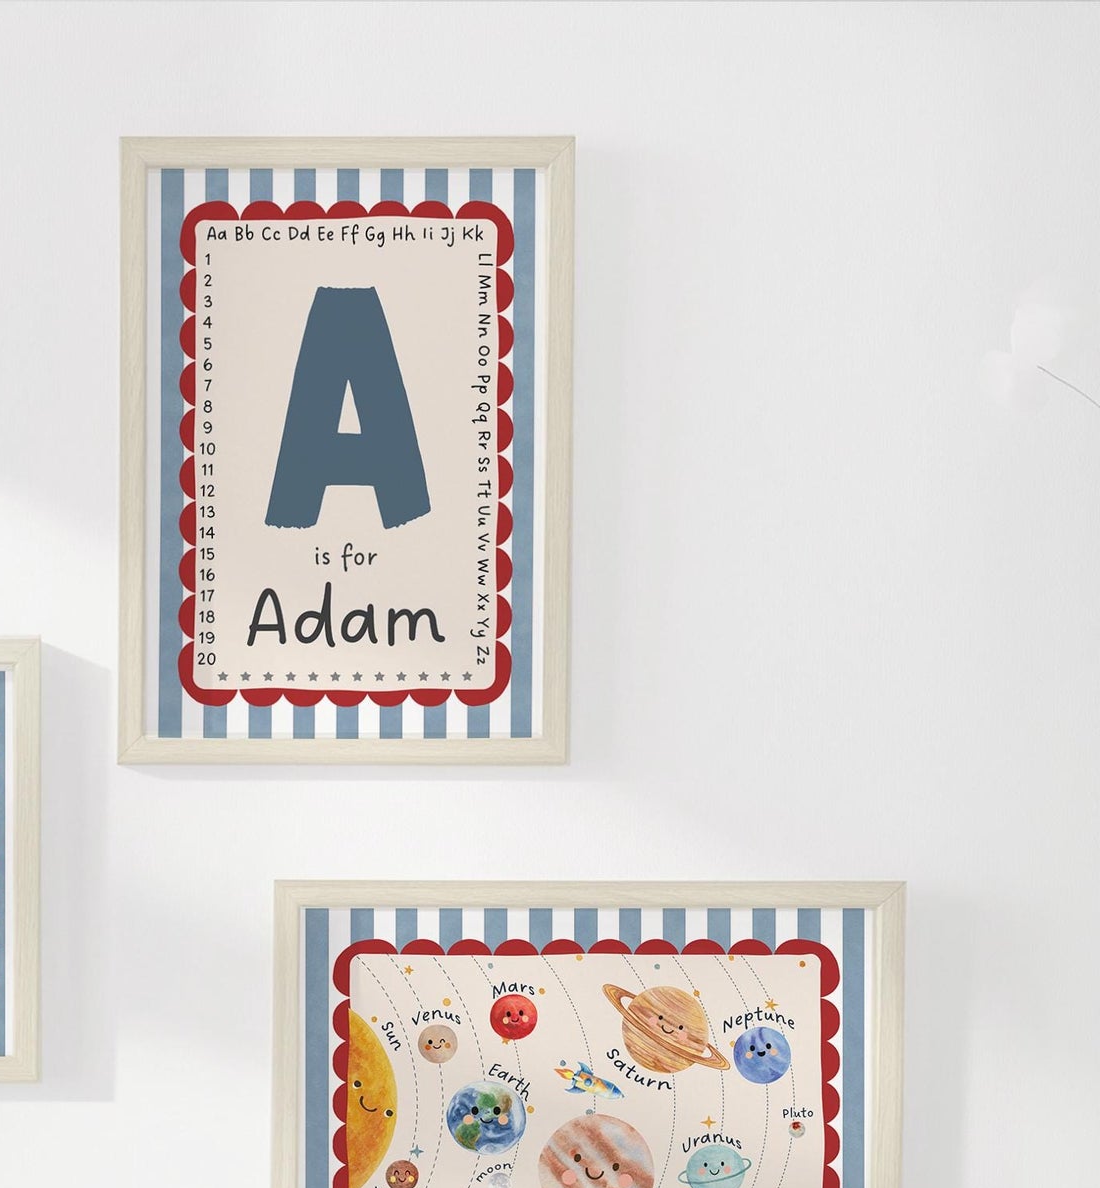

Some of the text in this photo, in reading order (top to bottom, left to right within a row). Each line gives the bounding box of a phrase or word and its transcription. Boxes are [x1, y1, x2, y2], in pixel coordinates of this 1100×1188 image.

[206, 224, 484, 248] Aa Bb Cc Dd Ee Ff Gg Hh Ii Jj Kk
[204, 253, 212, 266] 1
[203, 274, 212, 287] 2
[203, 295, 213, 308] 3
[202, 316, 213, 329] 4
[203, 337, 213, 351] 5
[203, 358, 213, 372] 6
[203, 379, 213, 392] 7
[203, 401, 213, 414] 8
[264, 286, 432, 530] A
[203, 421, 213, 434] 9
[199, 442, 216, 455] 10
[470, 253, 494, 665] Ll Mm Nn Oo Pp Qq Rr Ss Tt Uu Vv Ww Xx Yy Zz
[201, 463, 214, 476] 11
[200, 484, 216, 497] 12
[199, 505, 216, 519] 13
[199, 526, 216, 539] 14
[199, 547, 216, 561] 15
[314, 542, 378, 572] is for
[199, 568, 216, 581] 16
[200, 589, 215, 602] 17
[199, 609, 215, 623] 18
[246, 581, 446, 648] Adam
[199, 631, 216, 645] 19
[197, 652, 216, 666] 20
[491, 981, 536, 1000] Mars
[410, 1007, 462, 1026] Venus
[722, 1006, 796, 1034] Neptune
[381, 1020, 402, 1052] Sun
[606, 1048, 672, 1091] Saturn
[487, 1063, 532, 1102] Earth
[782, 1107, 814, 1119] Pluto
[682, 1131, 743, 1153] Uranus
[475, 1162, 513, 1185] moon
